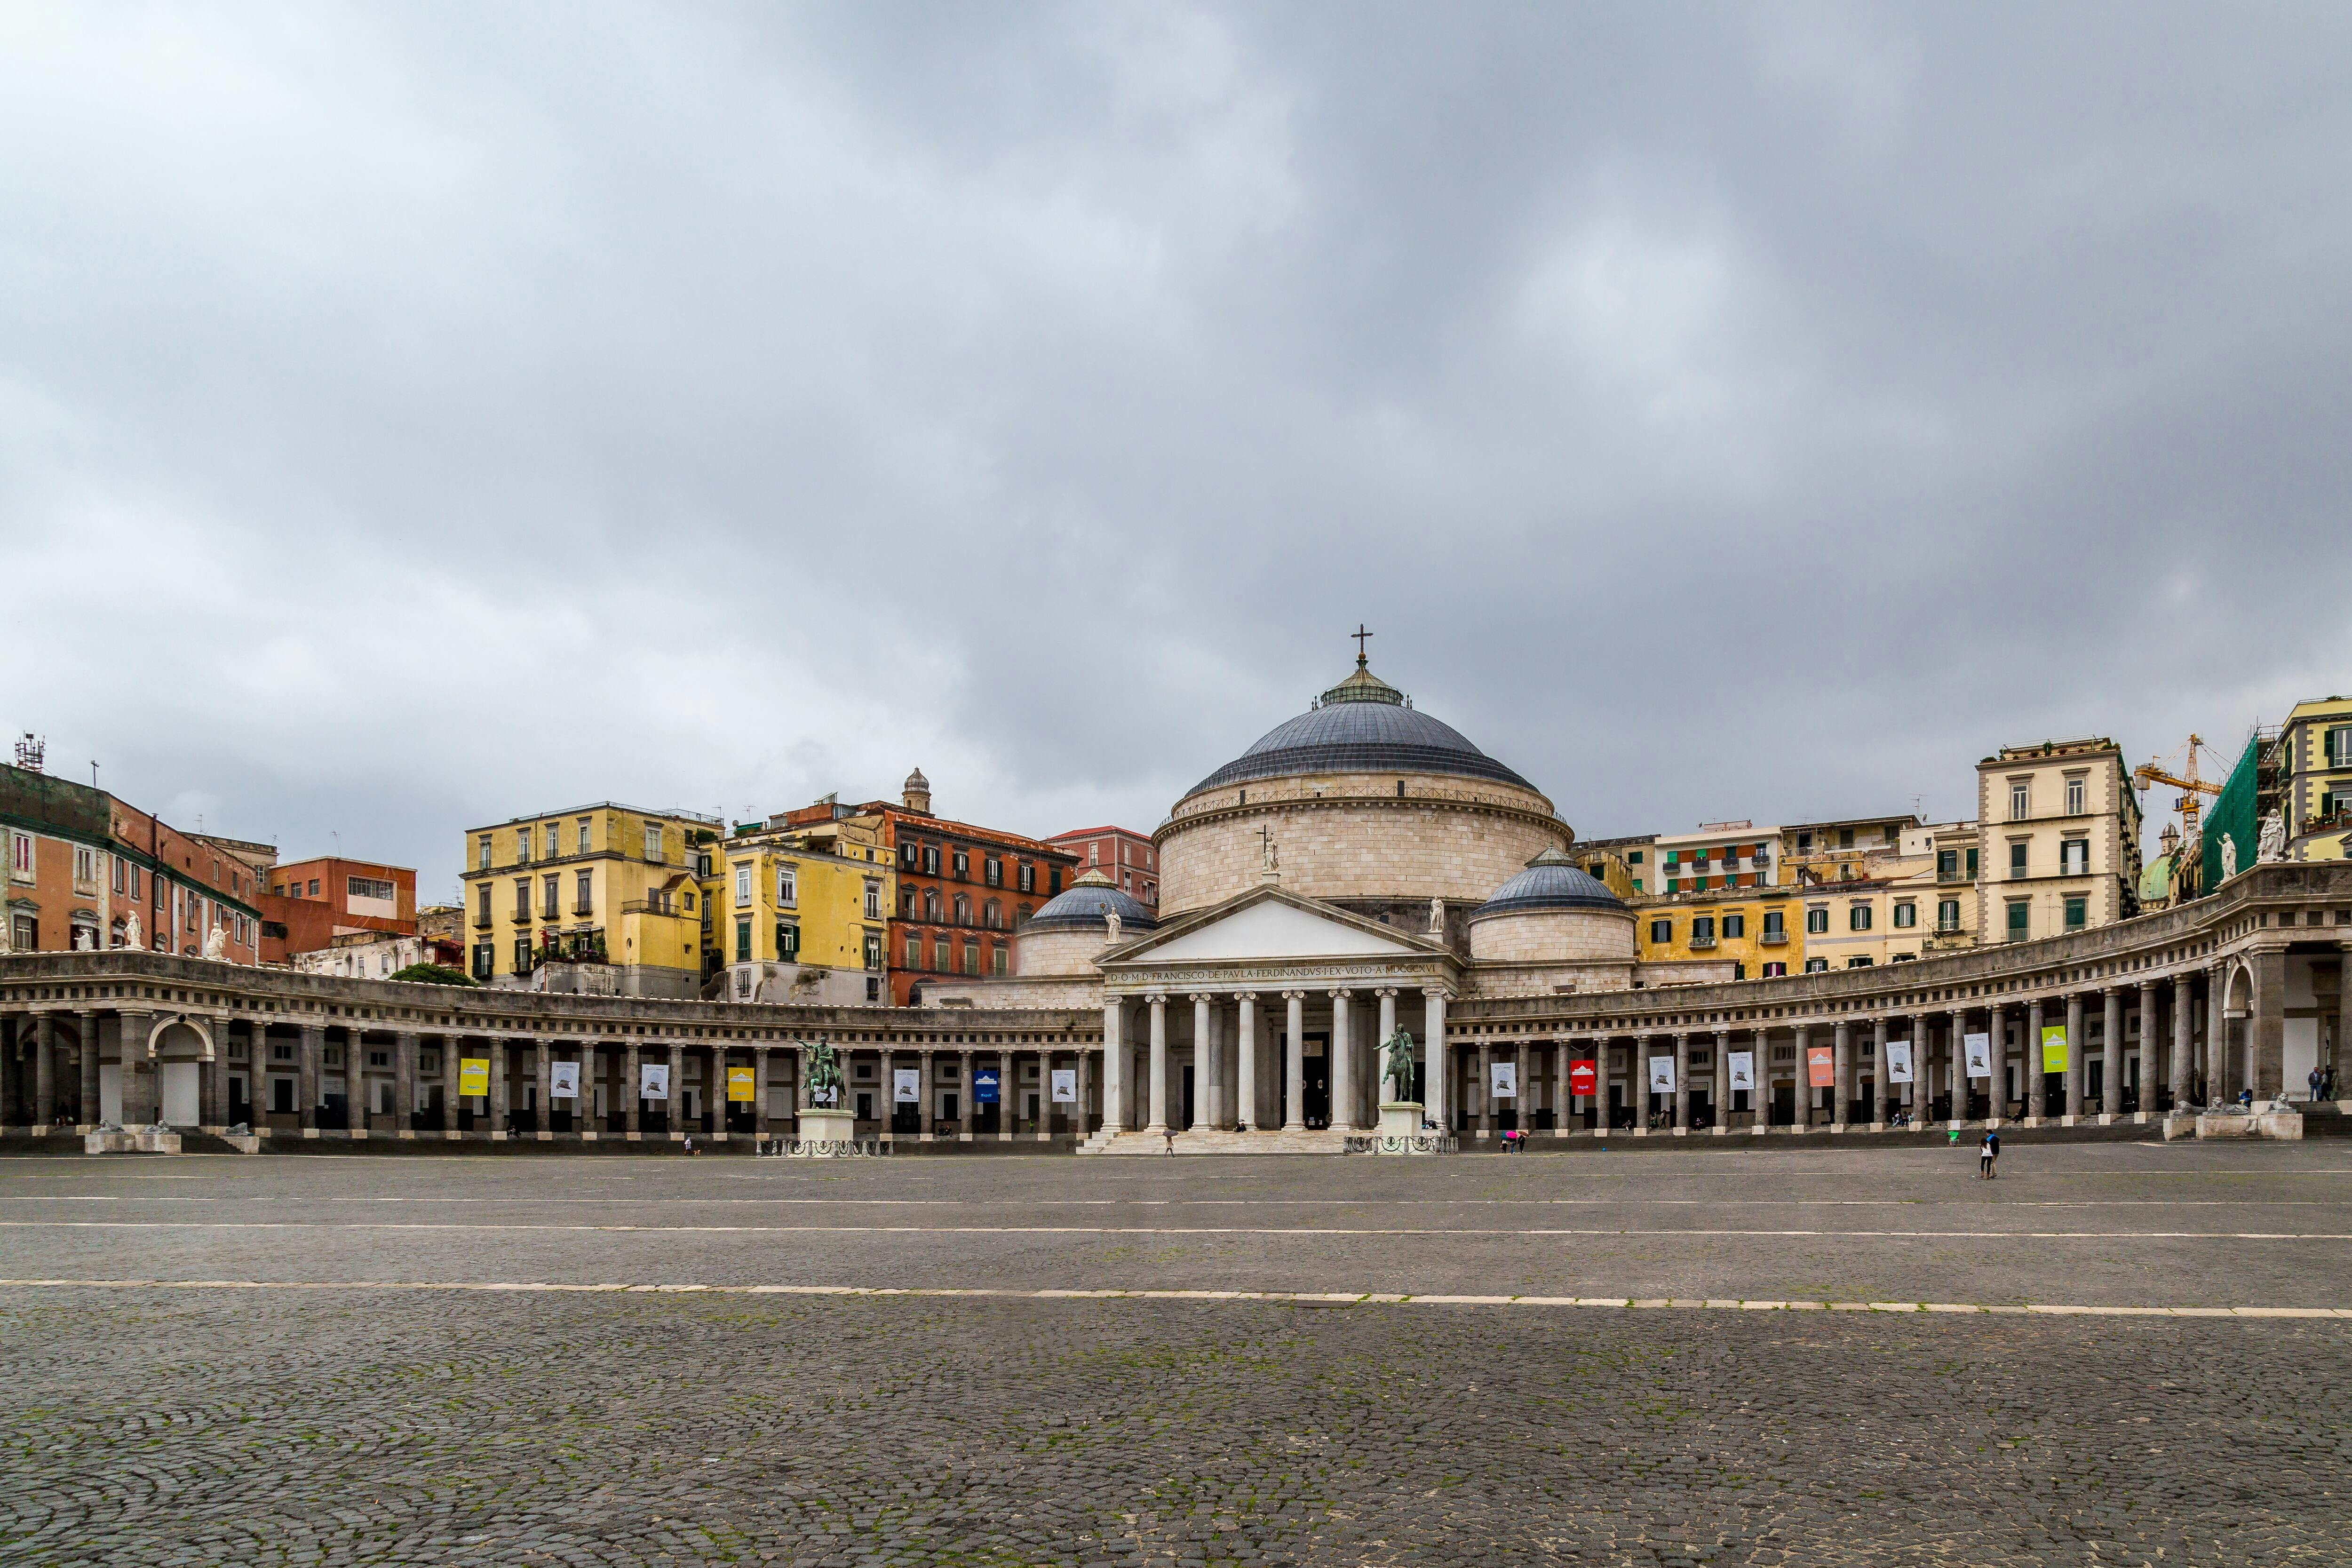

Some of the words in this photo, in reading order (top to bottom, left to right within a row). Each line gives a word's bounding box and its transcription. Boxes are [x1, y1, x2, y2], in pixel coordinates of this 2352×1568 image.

[1152, 971, 1205, 980] FRANCISCO
[1208, 971, 1220, 979] DE
[1330, 967, 1342, 975] EX
[1345, 966, 1372, 975] VOTO
[1385, 964, 1436, 973] MDCCCXVI
